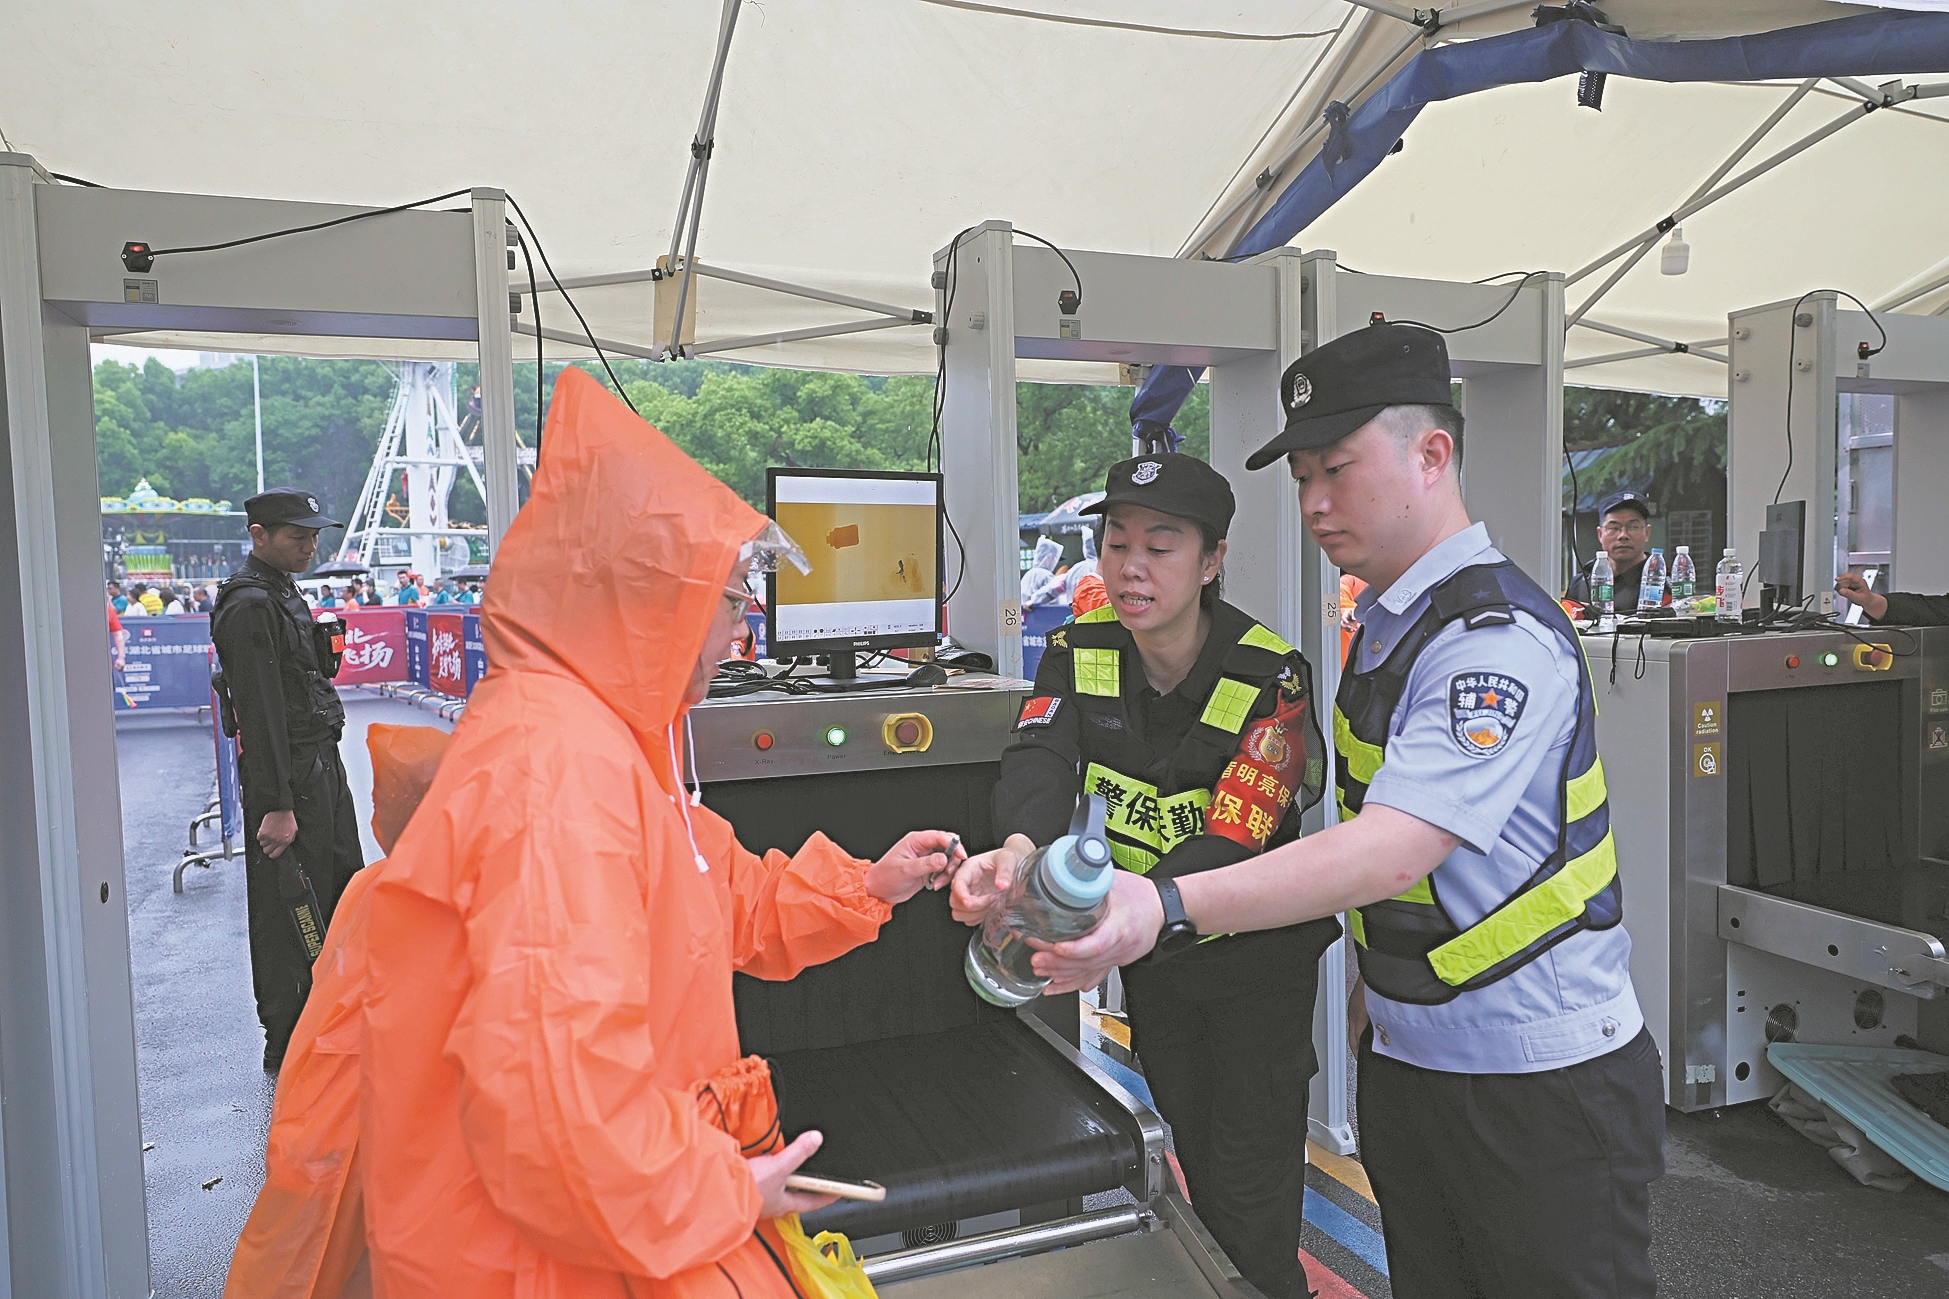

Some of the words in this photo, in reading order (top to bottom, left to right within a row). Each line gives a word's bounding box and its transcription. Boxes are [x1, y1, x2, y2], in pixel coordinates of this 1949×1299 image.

[1005, 608, 1017, 626] 26
[1327, 602, 1337, 618] 25
[1455, 675, 1525, 702] 中华人民共和国
[1457, 692, 1477, 709] 辅
[1503, 697, 1518, 717] 警
[304, 931, 322, 957] SUPER
